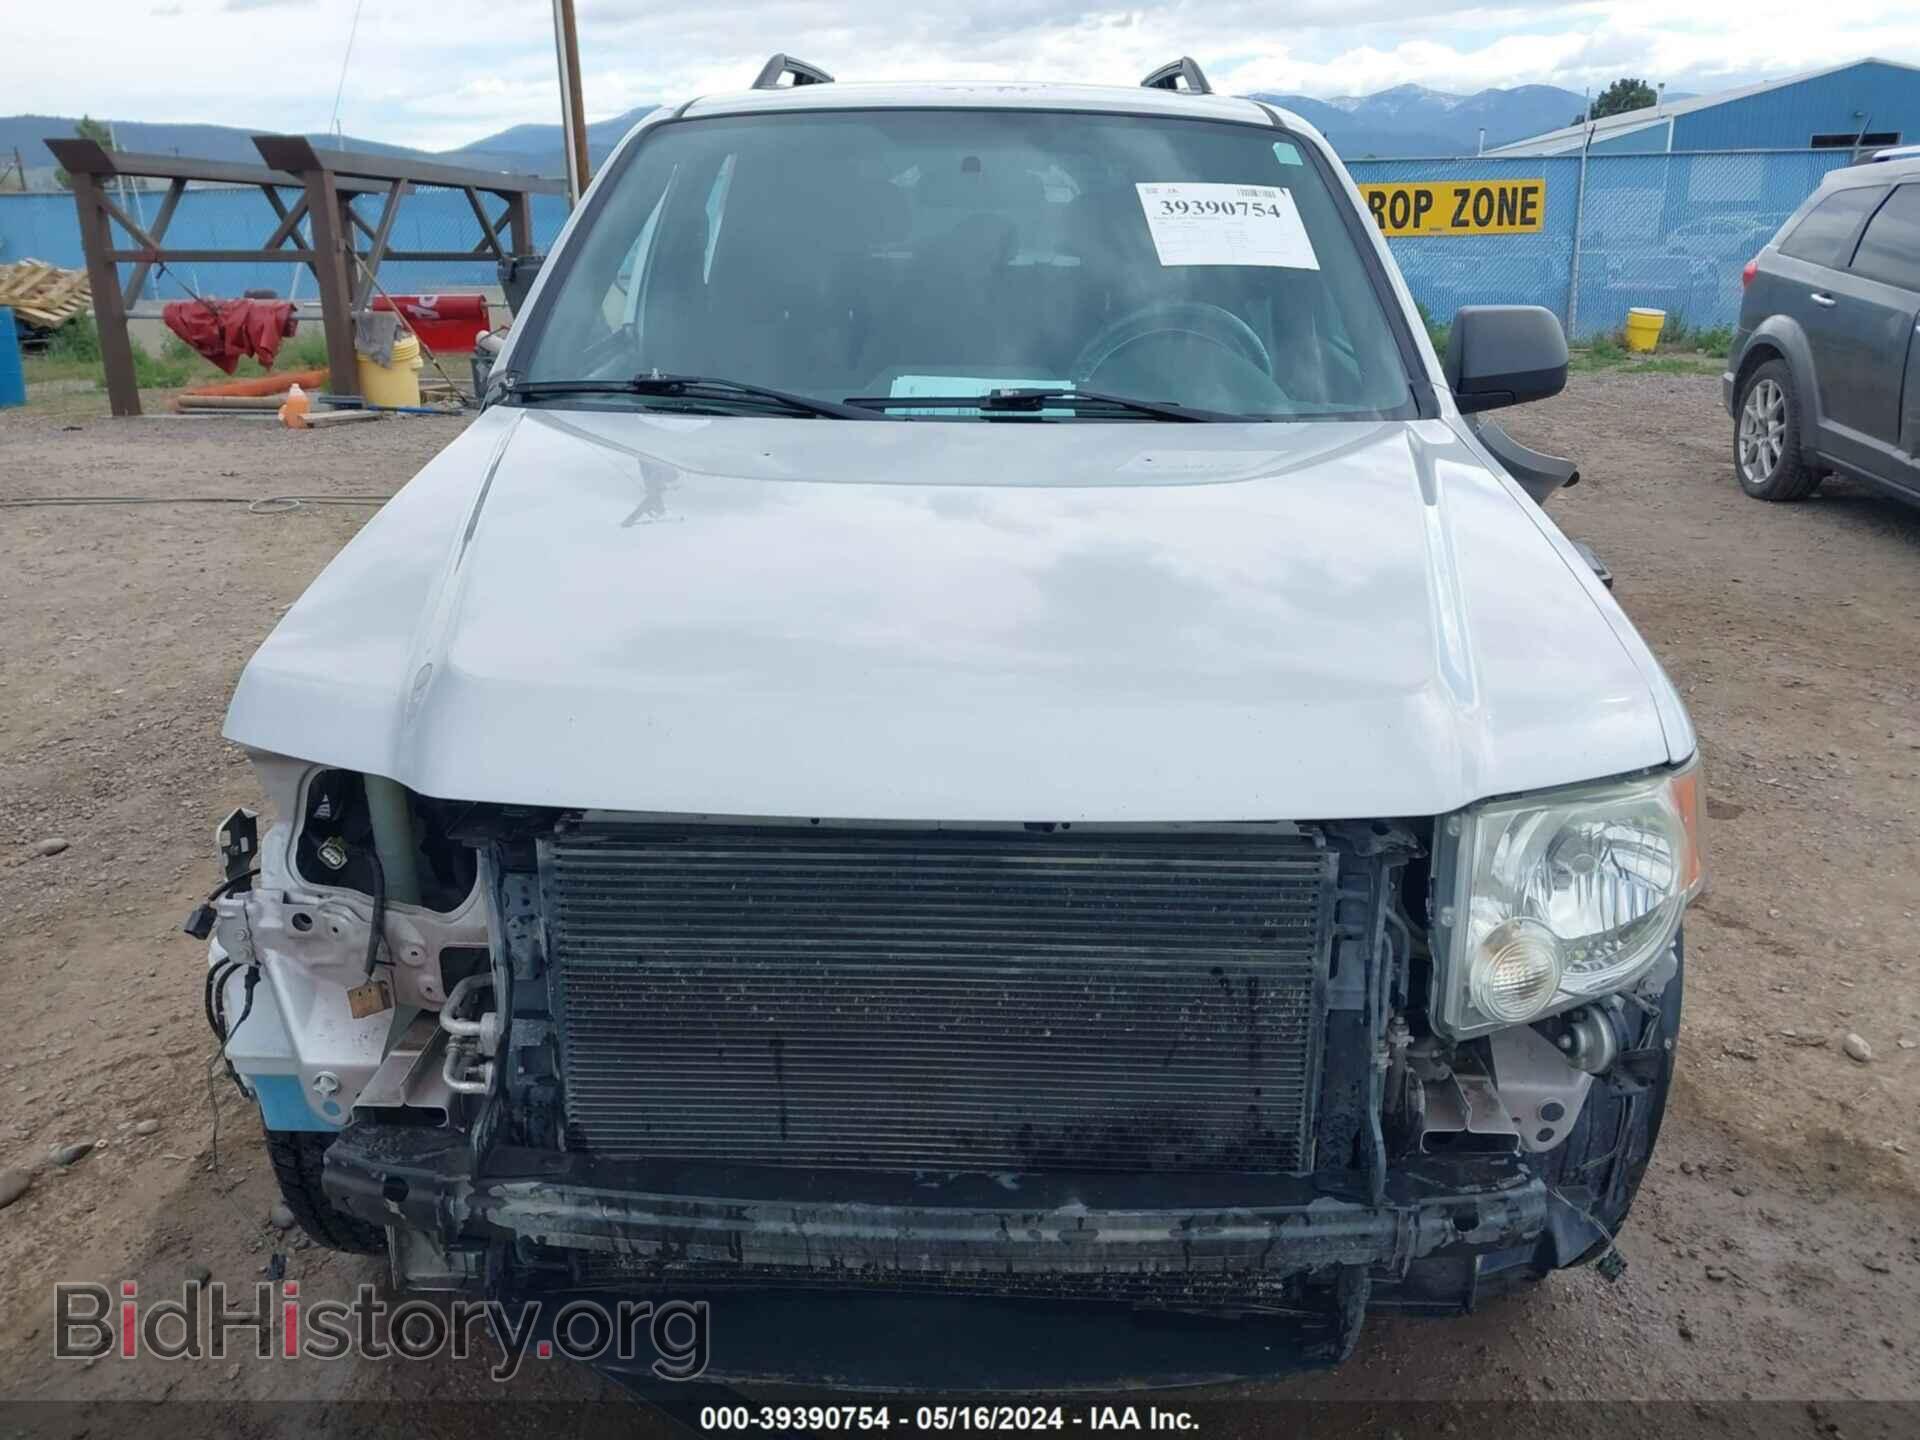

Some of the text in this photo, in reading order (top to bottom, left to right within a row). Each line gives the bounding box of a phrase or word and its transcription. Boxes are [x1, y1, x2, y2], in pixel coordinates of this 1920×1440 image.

[1160, 200, 1281, 218] 39390754
[1367, 186, 1539, 230] ROP ZONE
